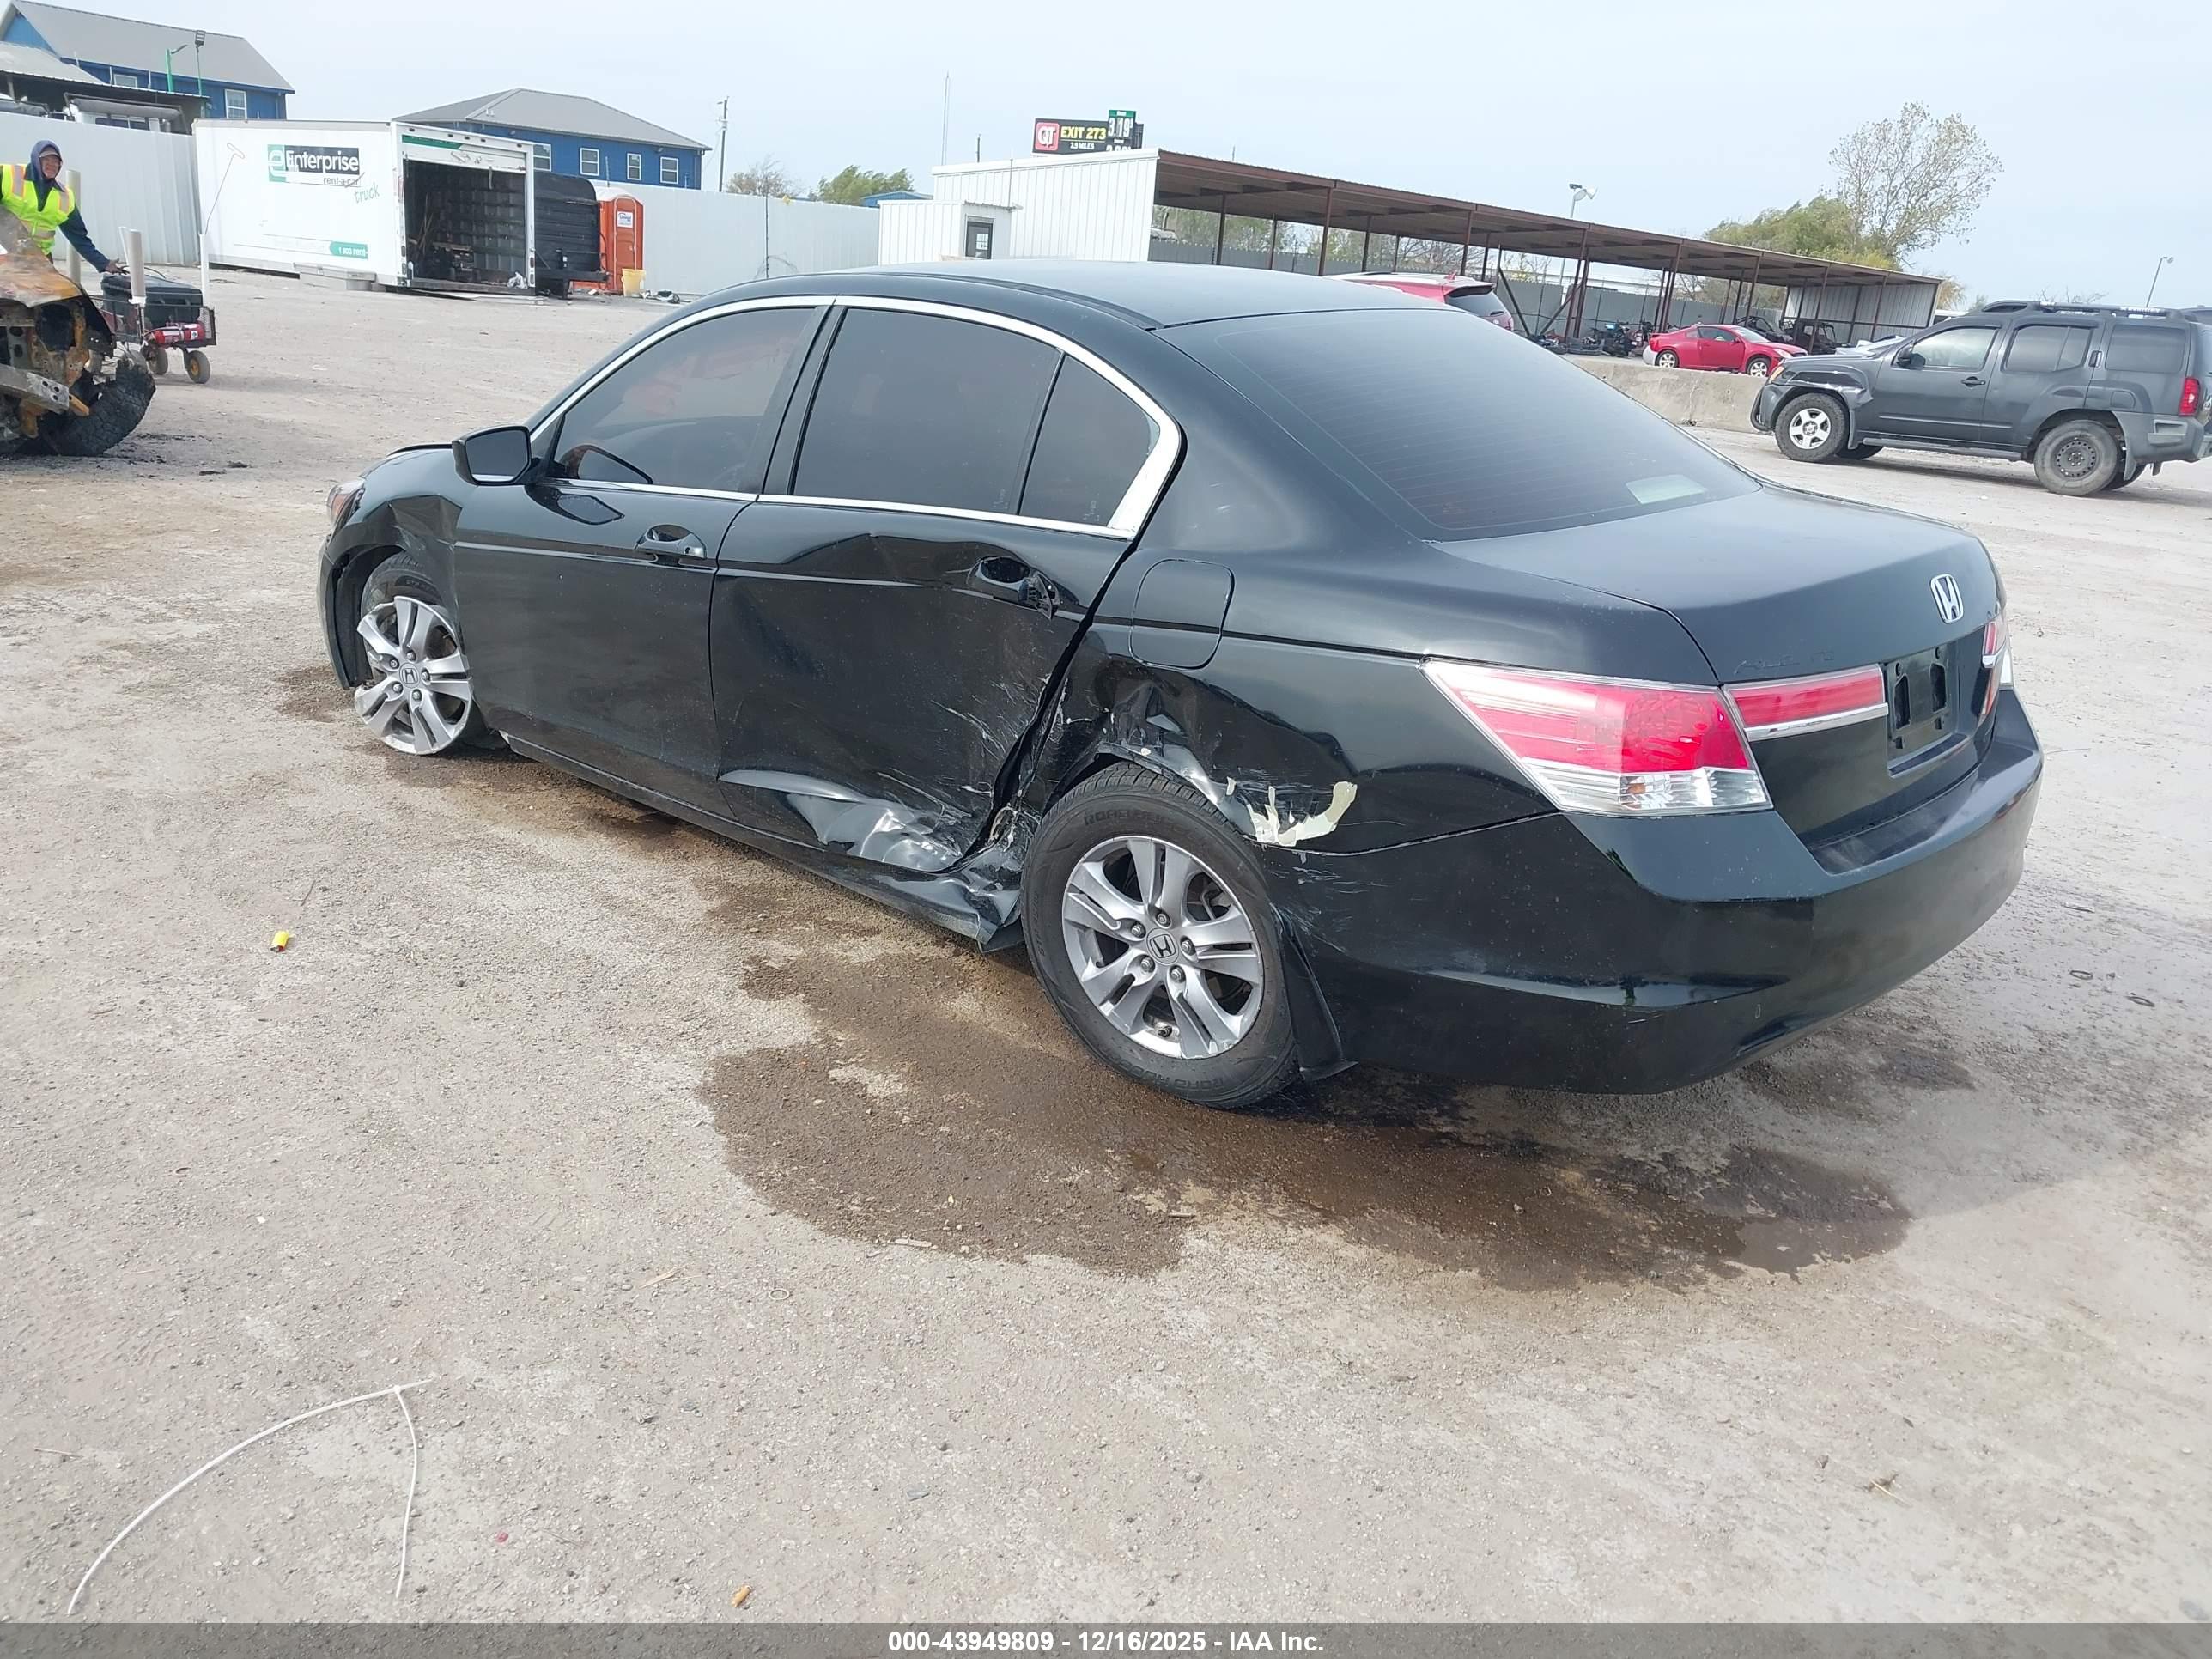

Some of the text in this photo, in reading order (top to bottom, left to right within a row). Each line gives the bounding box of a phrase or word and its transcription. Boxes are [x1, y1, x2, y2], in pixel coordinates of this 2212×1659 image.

[1037, 125, 1056, 148] QT
[1060, 125, 1107, 140] EXIT 273
[354, 181, 380, 204] truck
